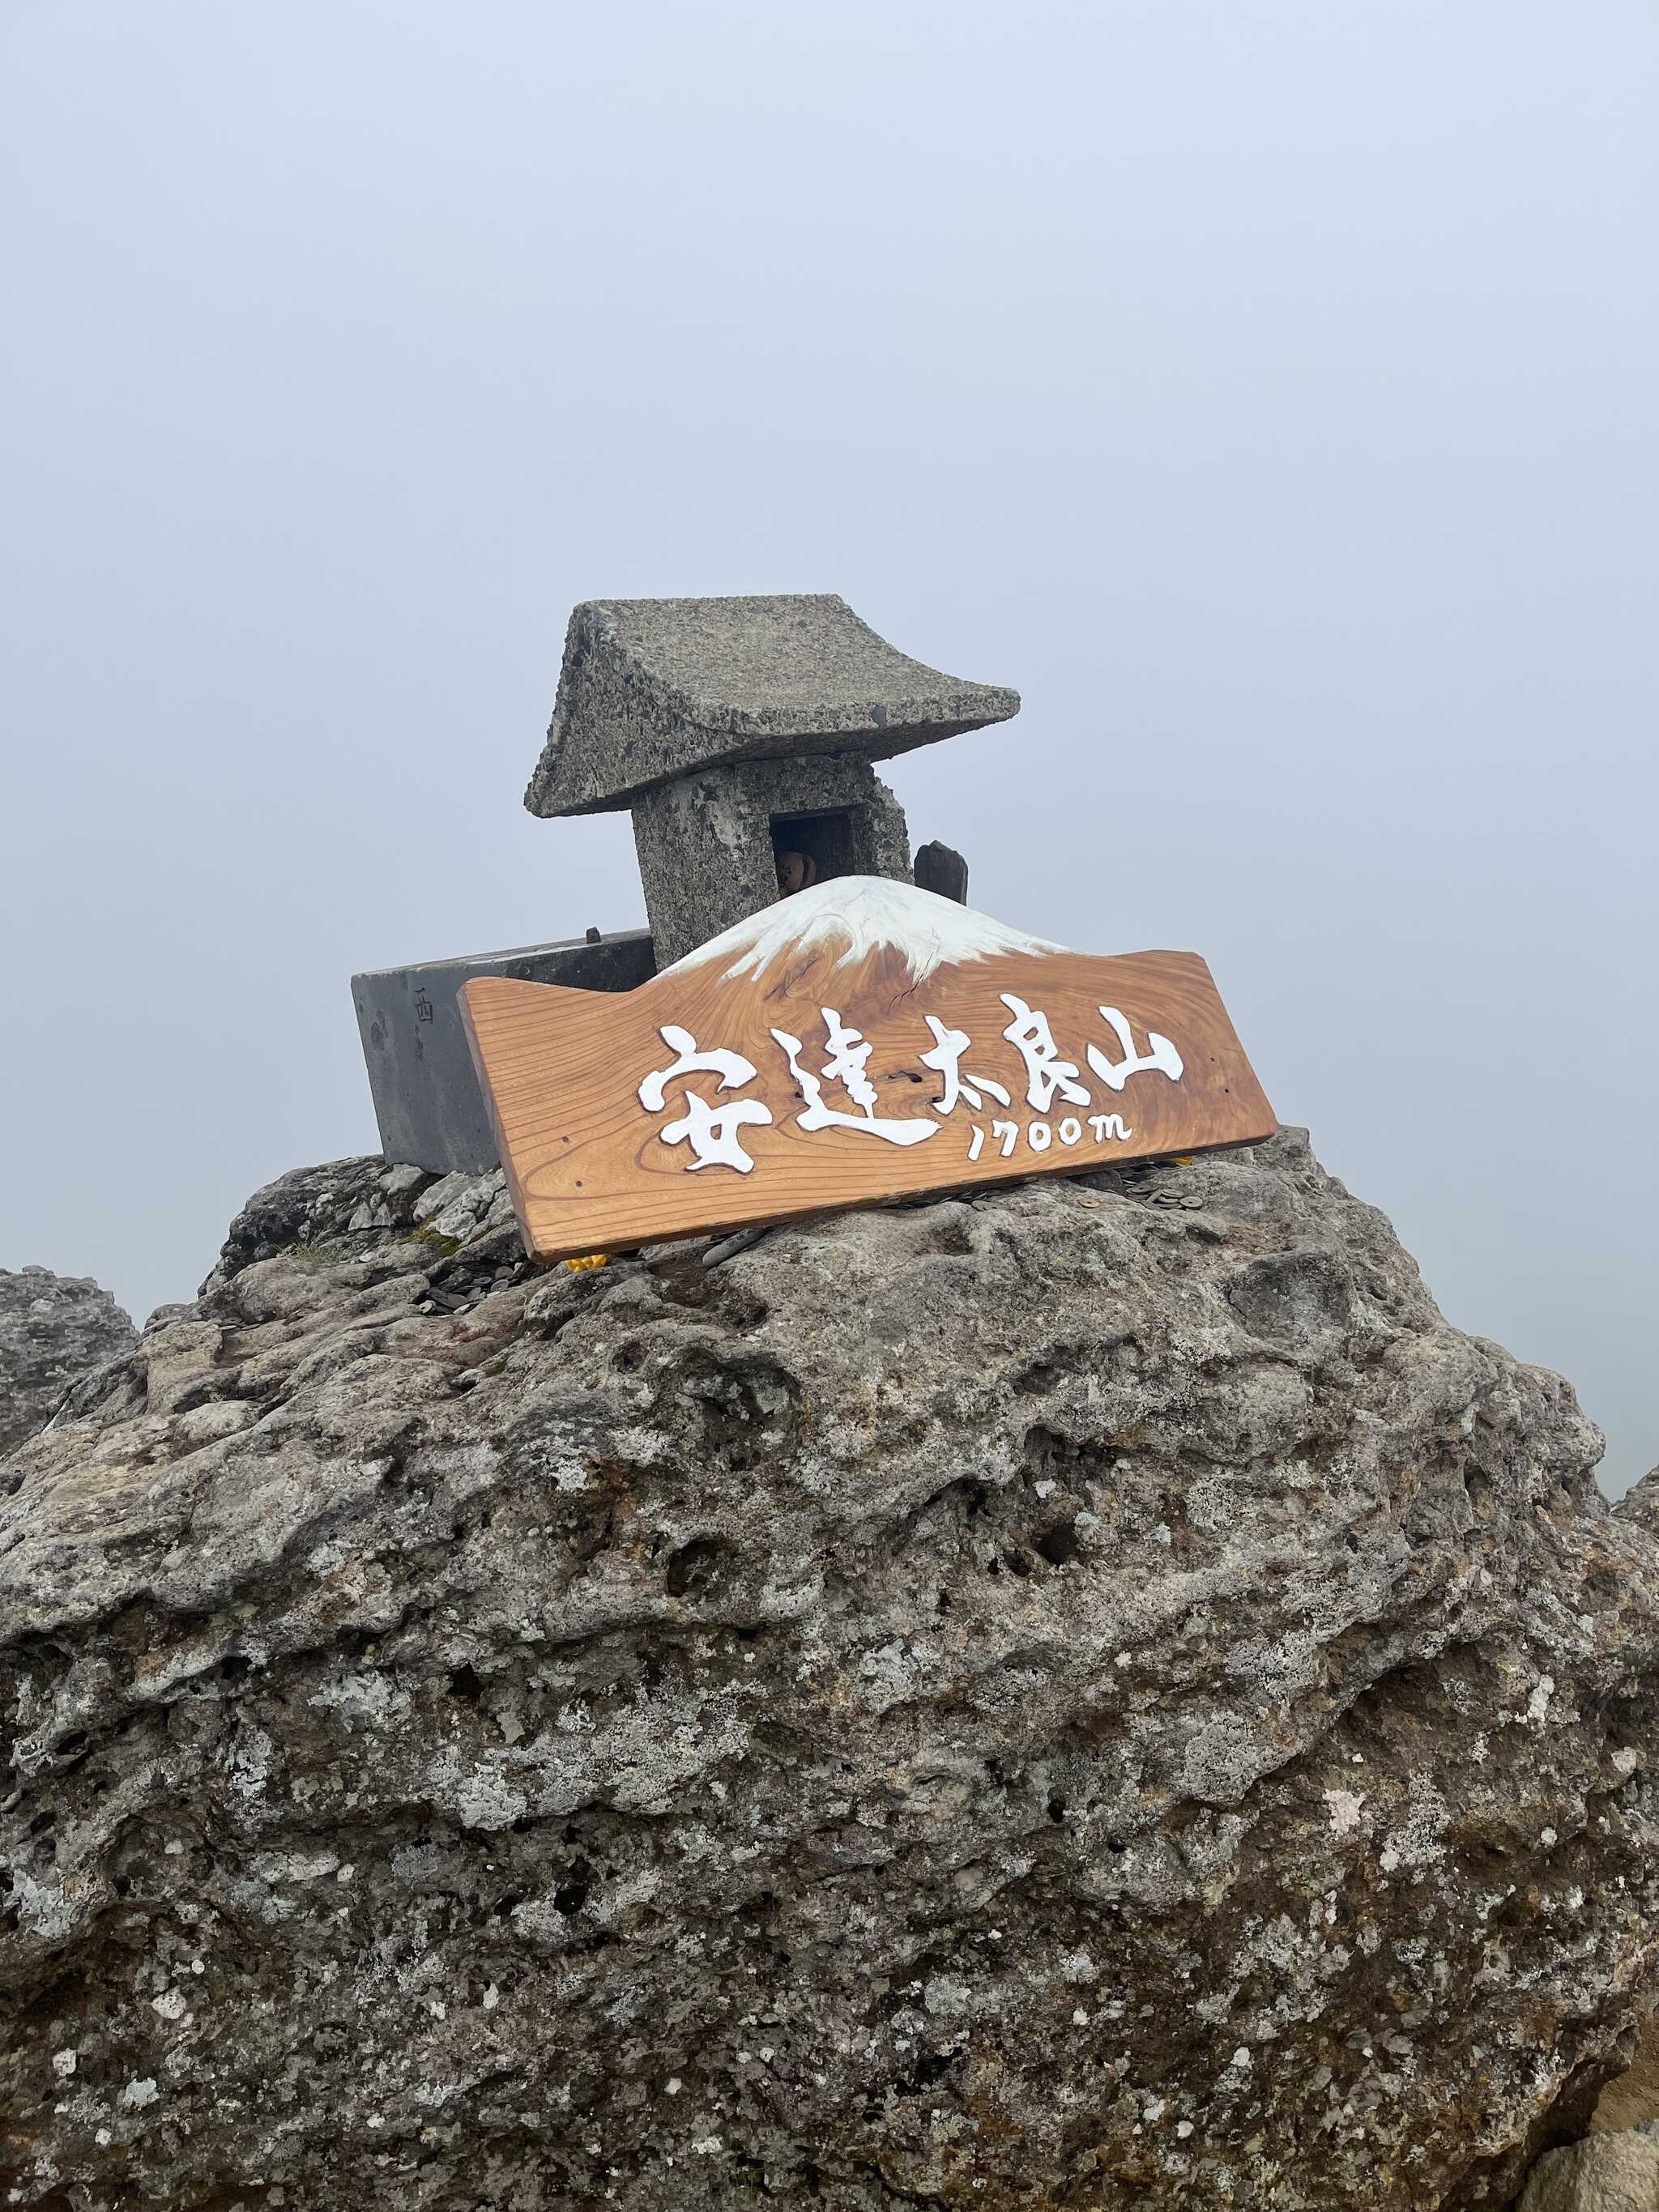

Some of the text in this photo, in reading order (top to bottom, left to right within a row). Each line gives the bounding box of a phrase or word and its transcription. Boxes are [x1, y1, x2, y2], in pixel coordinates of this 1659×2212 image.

[638, 992, 1185, 1174] 安達太良山
